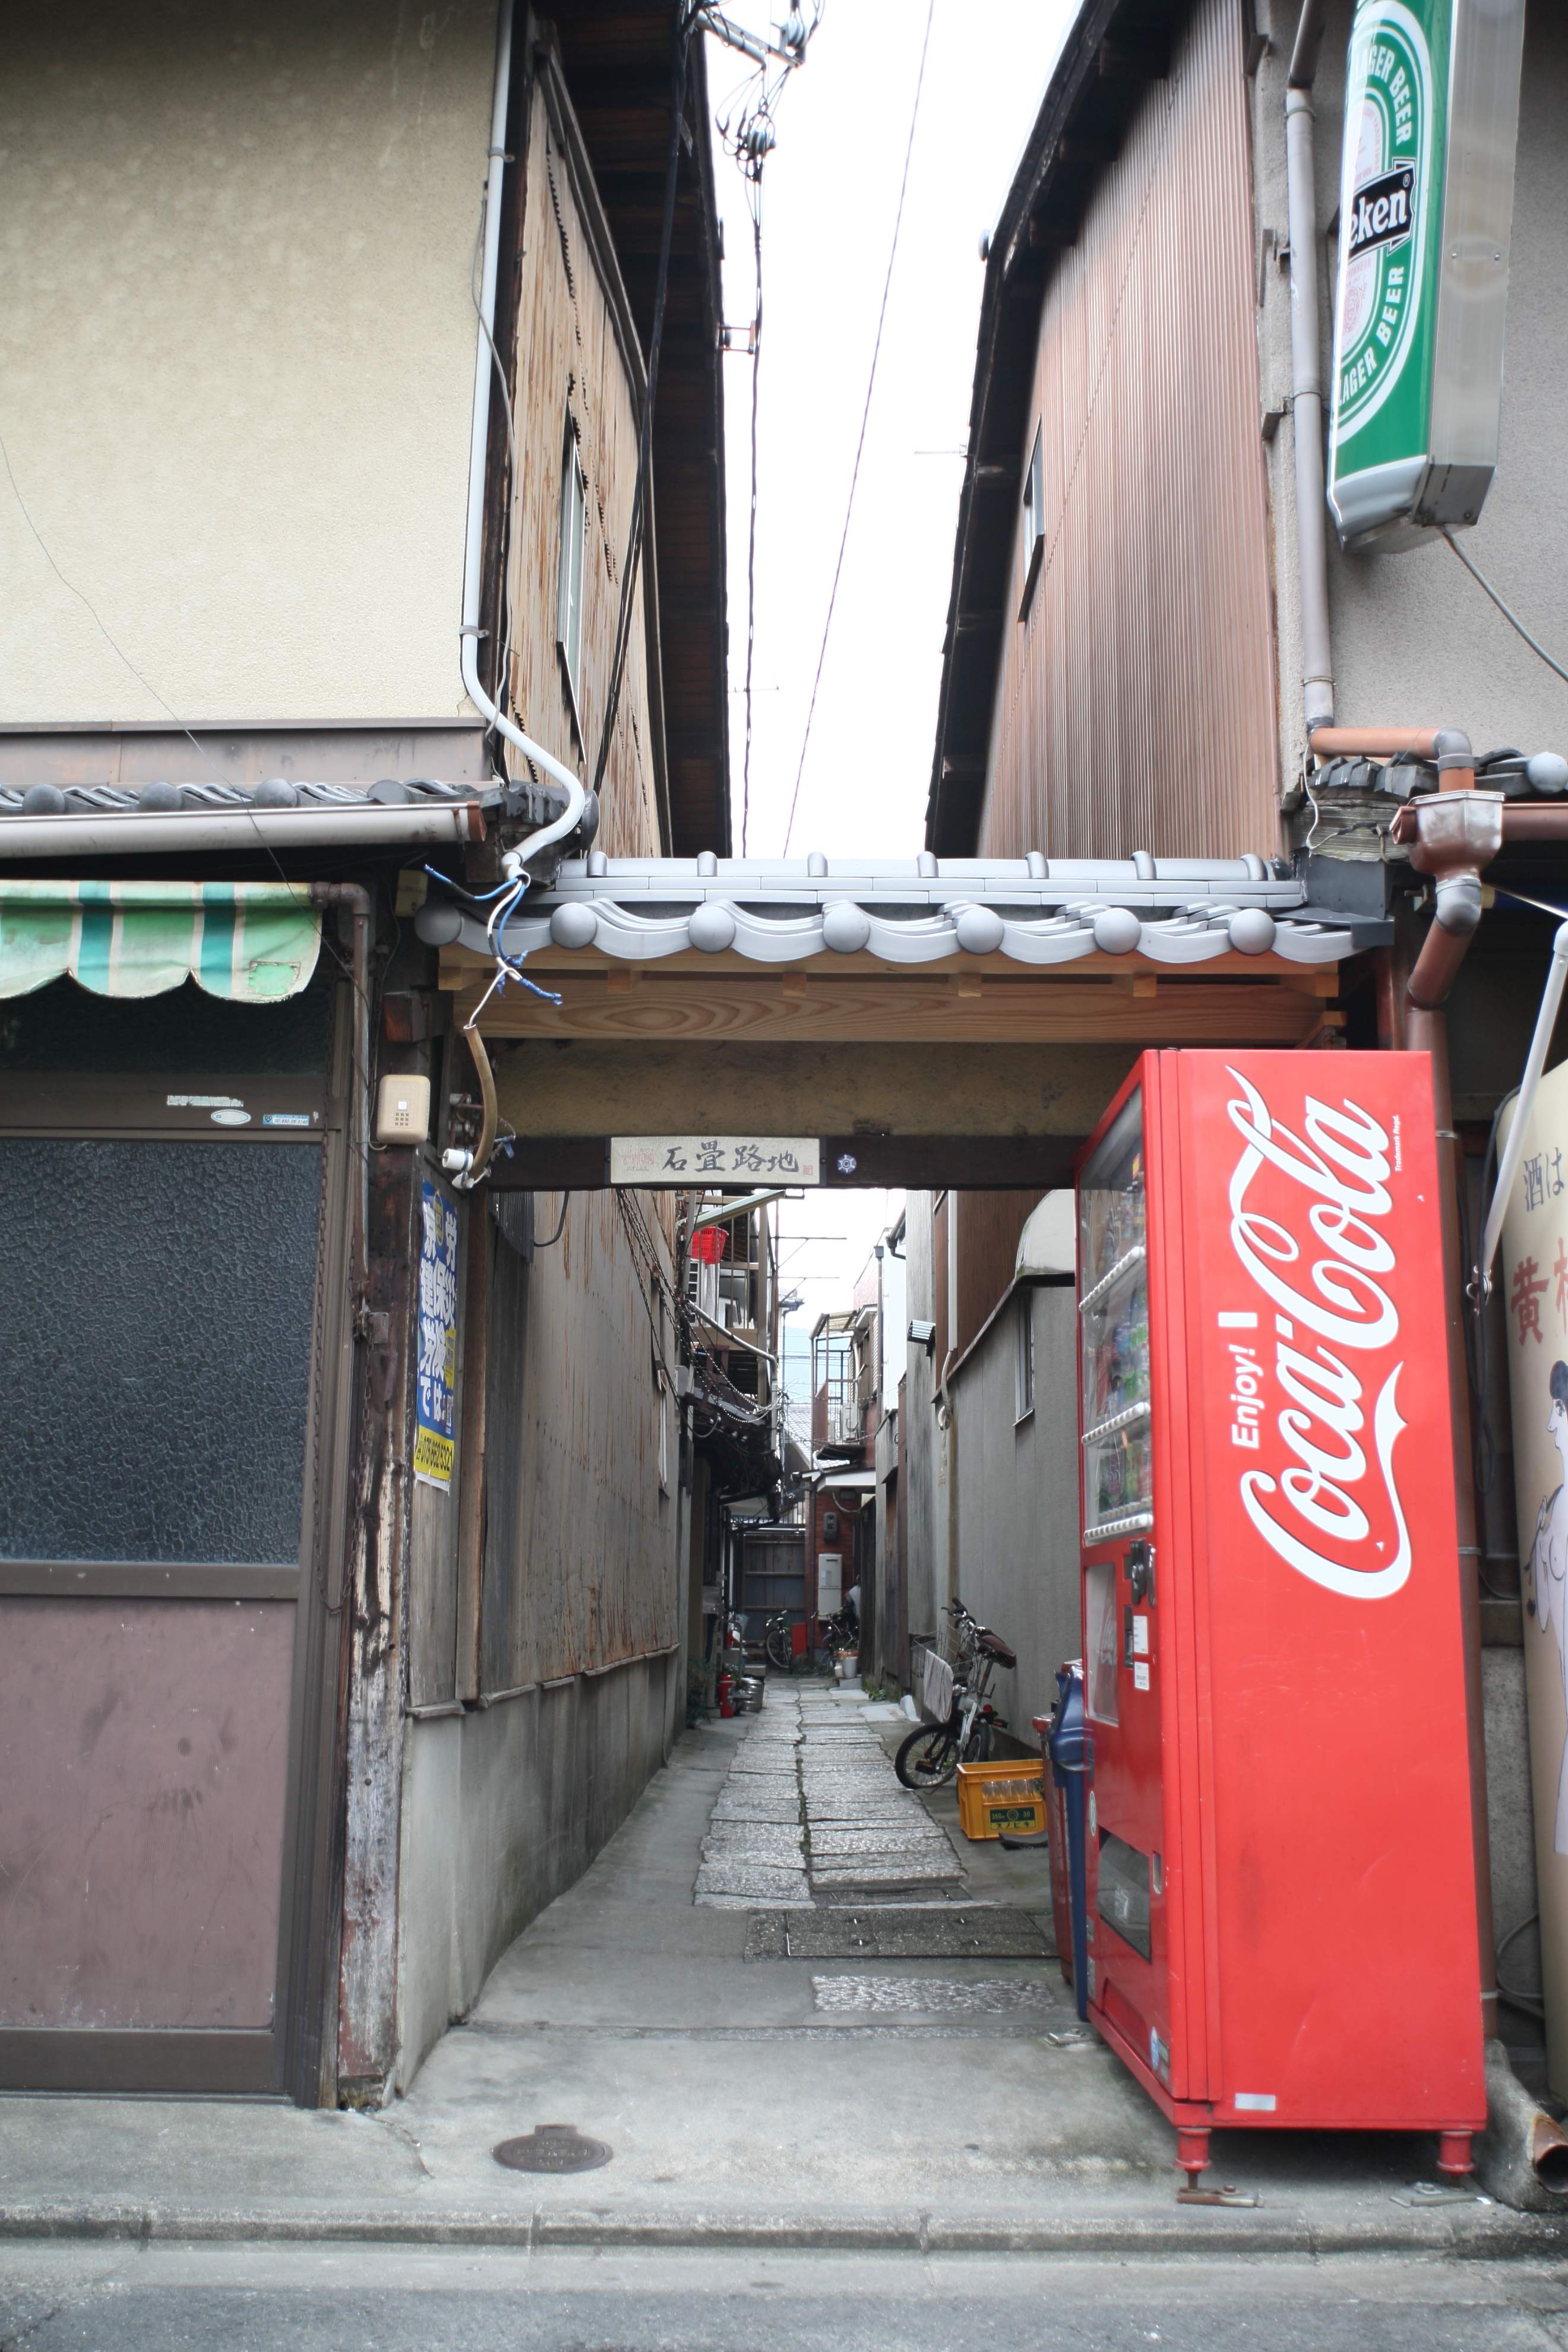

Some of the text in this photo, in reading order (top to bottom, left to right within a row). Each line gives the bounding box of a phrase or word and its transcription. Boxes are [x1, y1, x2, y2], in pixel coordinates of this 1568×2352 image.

[1389, 66, 1413, 146] BEER
[1375, 265, 1405, 347] BEER
[662, 1140, 799, 1172] 石畳路地
[1393, 1135, 1402, 1172] Trademark
[1522, 1146, 1565, 1212] 酒は
[1225, 1065, 1412, 1599] Coca-Cola
[1229, 1343, 1264, 1449] Enjoy!
